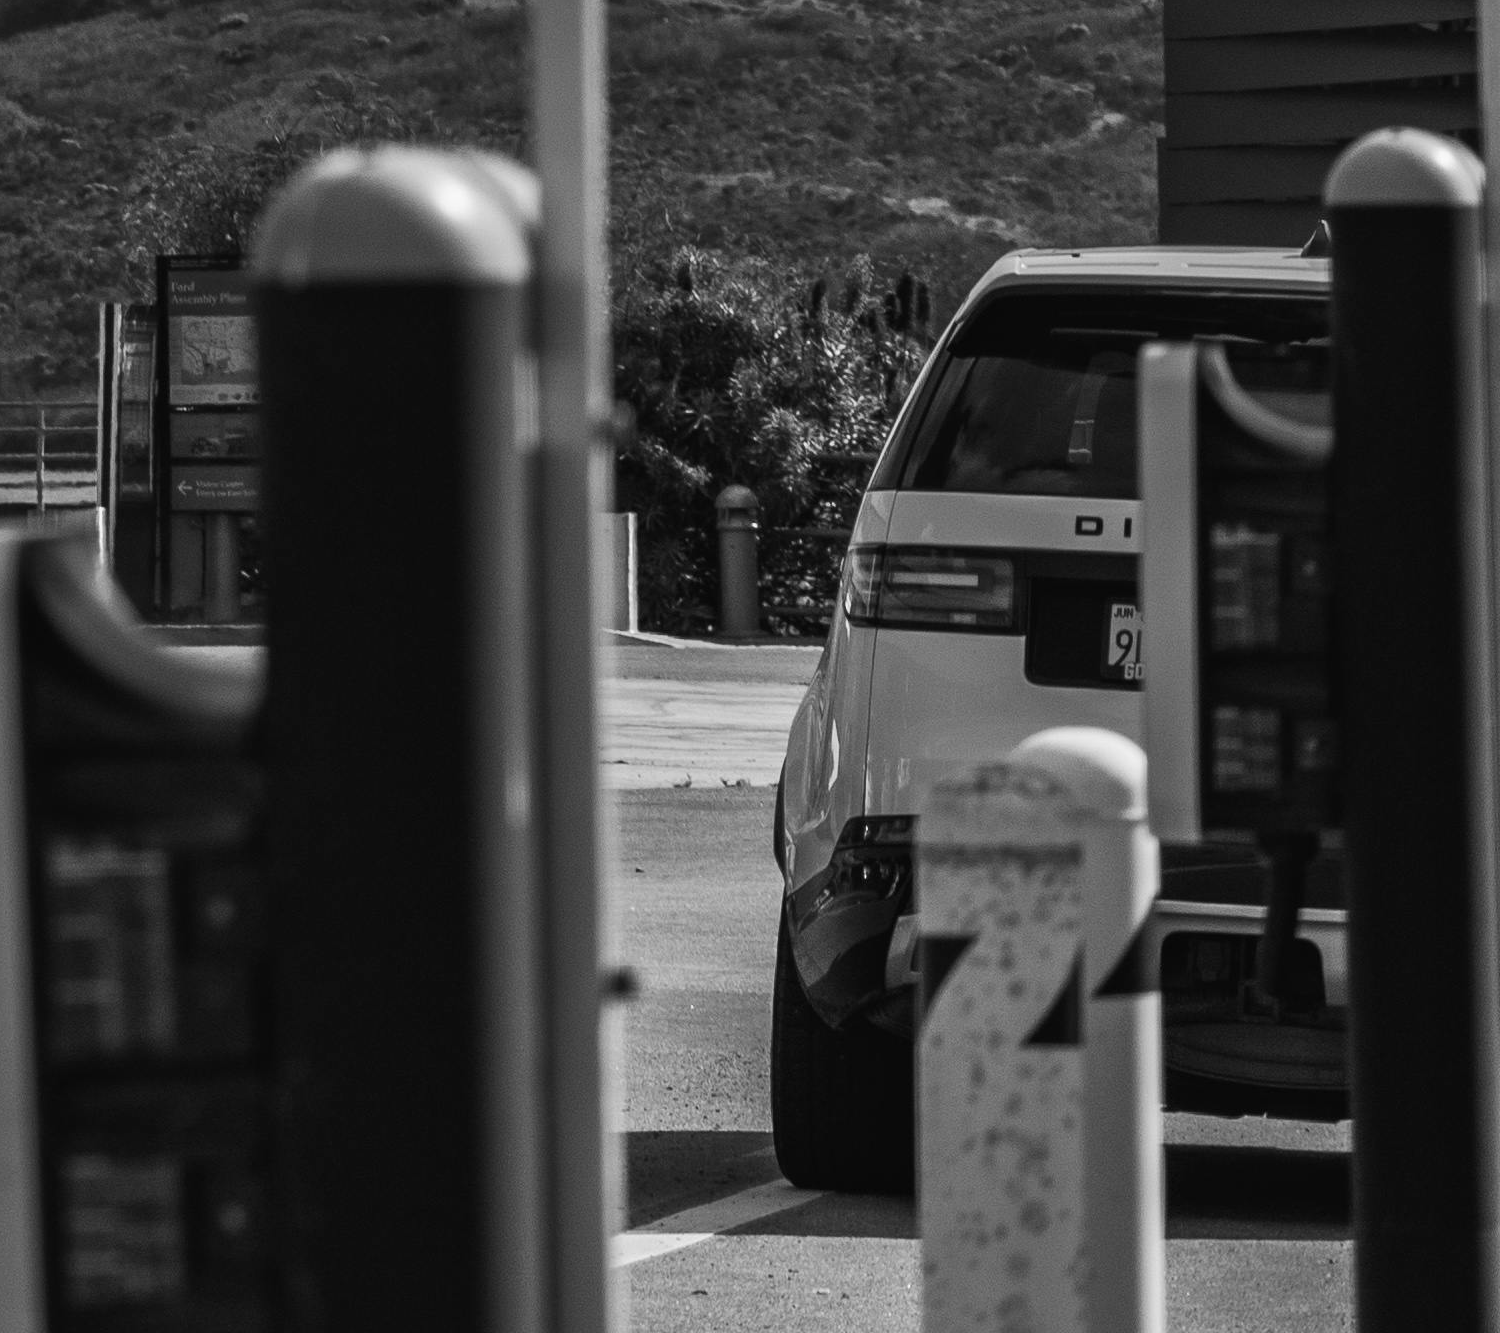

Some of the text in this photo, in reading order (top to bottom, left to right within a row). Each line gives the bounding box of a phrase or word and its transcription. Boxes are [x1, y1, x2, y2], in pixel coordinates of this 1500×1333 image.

[171, 282, 195, 292] Ford
[172, 294, 218, 307] Assembly
[1113, 607, 1134, 619] JUN
